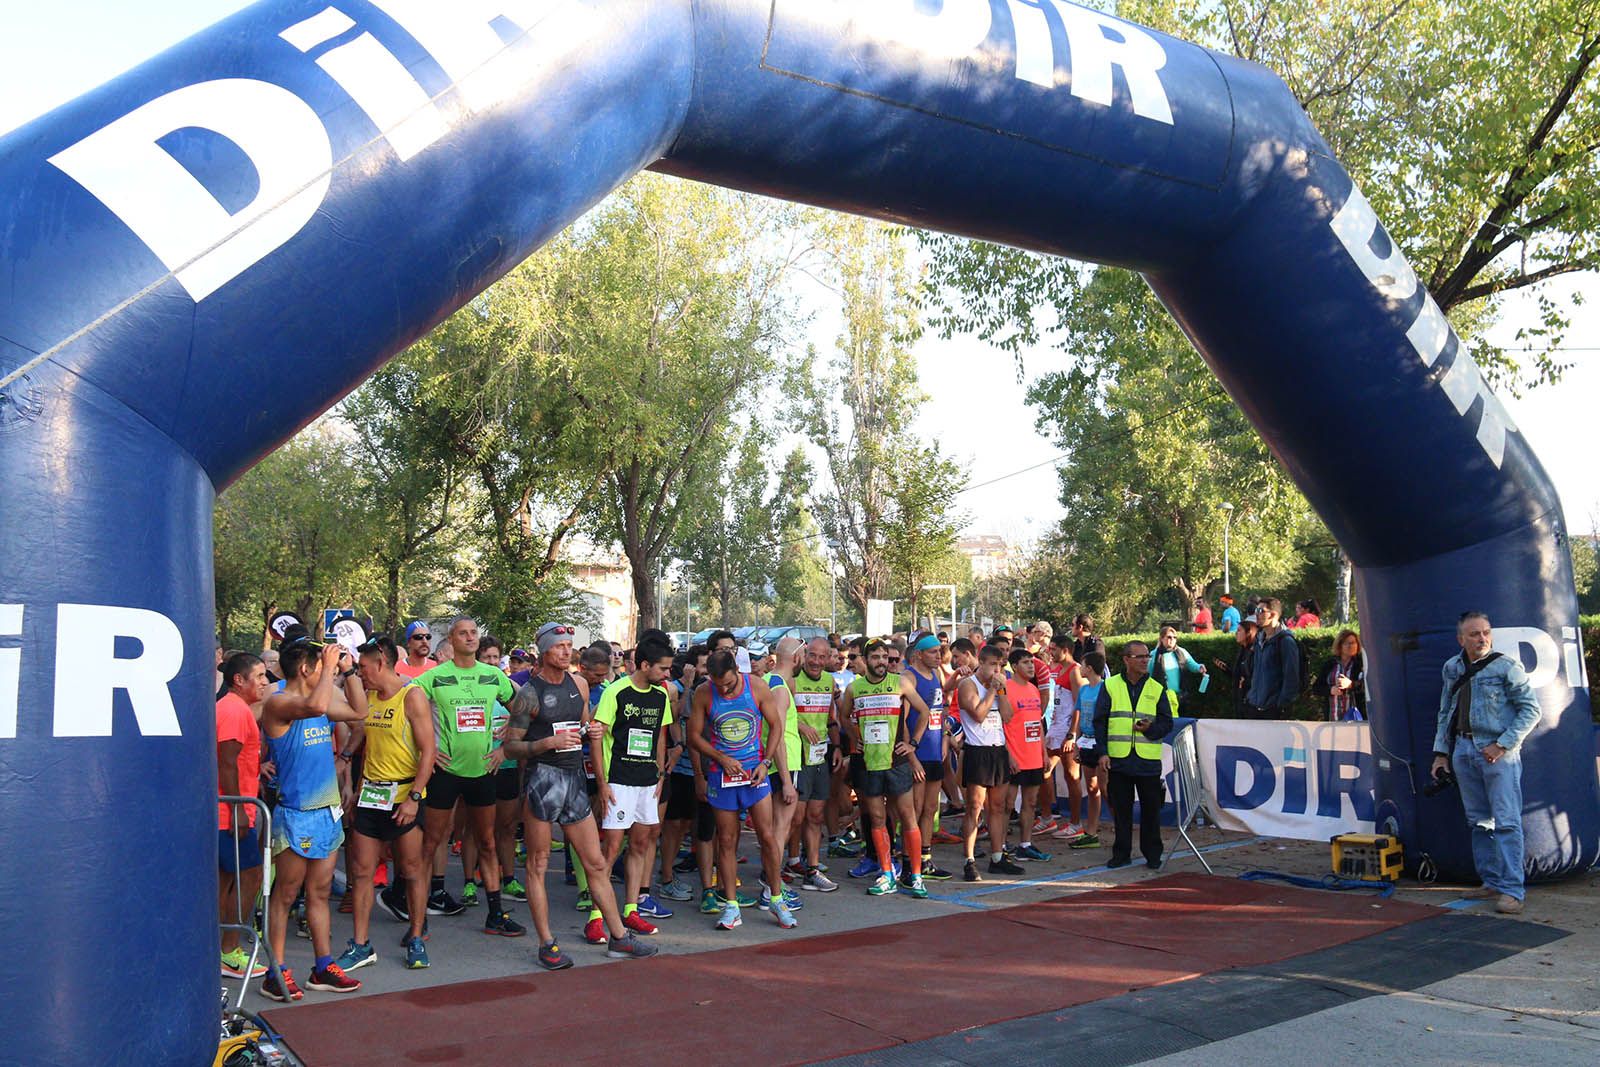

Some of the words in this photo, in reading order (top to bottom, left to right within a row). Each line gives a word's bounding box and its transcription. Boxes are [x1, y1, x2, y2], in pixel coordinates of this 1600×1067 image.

[1490, 626, 1589, 688] Di
[383, 708, 395, 720] LS
[1215, 745, 1376, 822] DiR
